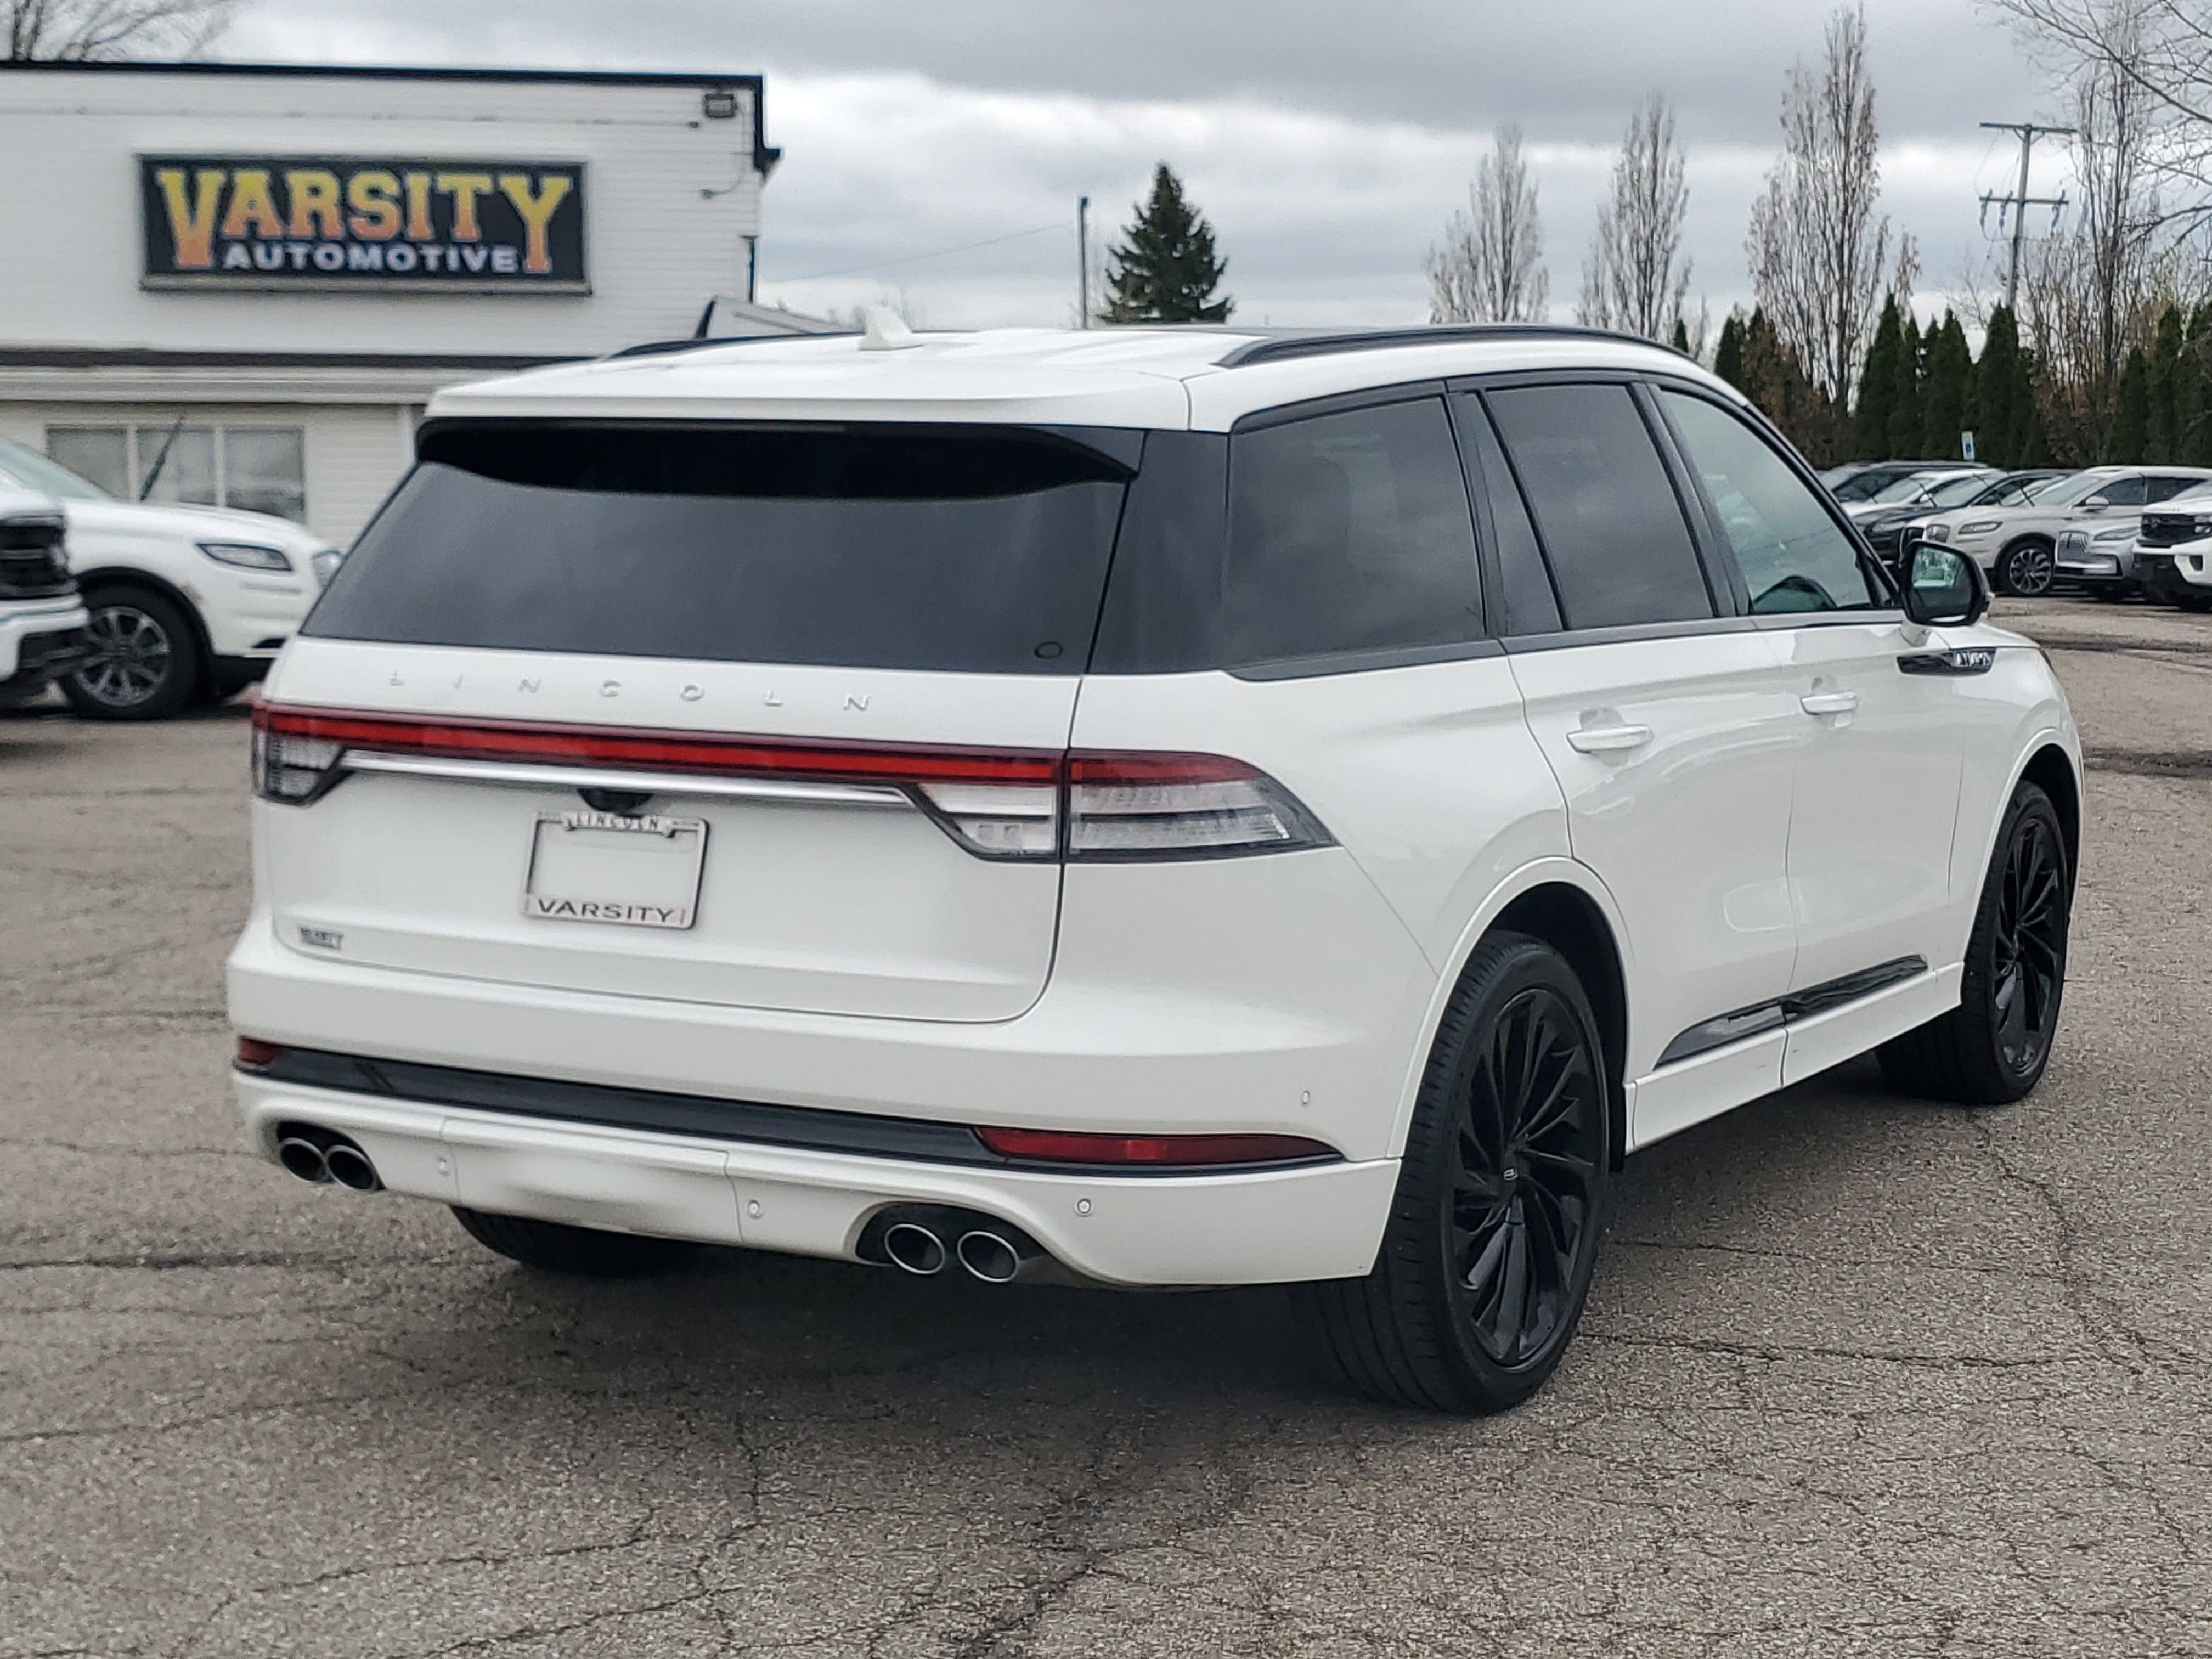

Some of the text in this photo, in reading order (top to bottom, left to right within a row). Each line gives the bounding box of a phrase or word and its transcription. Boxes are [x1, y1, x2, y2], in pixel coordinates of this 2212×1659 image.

[156, 167, 572, 274] VARSITY
[222, 241, 518, 273] AUTOMOTIVE
[388, 670, 871, 712] LINCOLN
[538, 898, 674, 922] VARSITY
